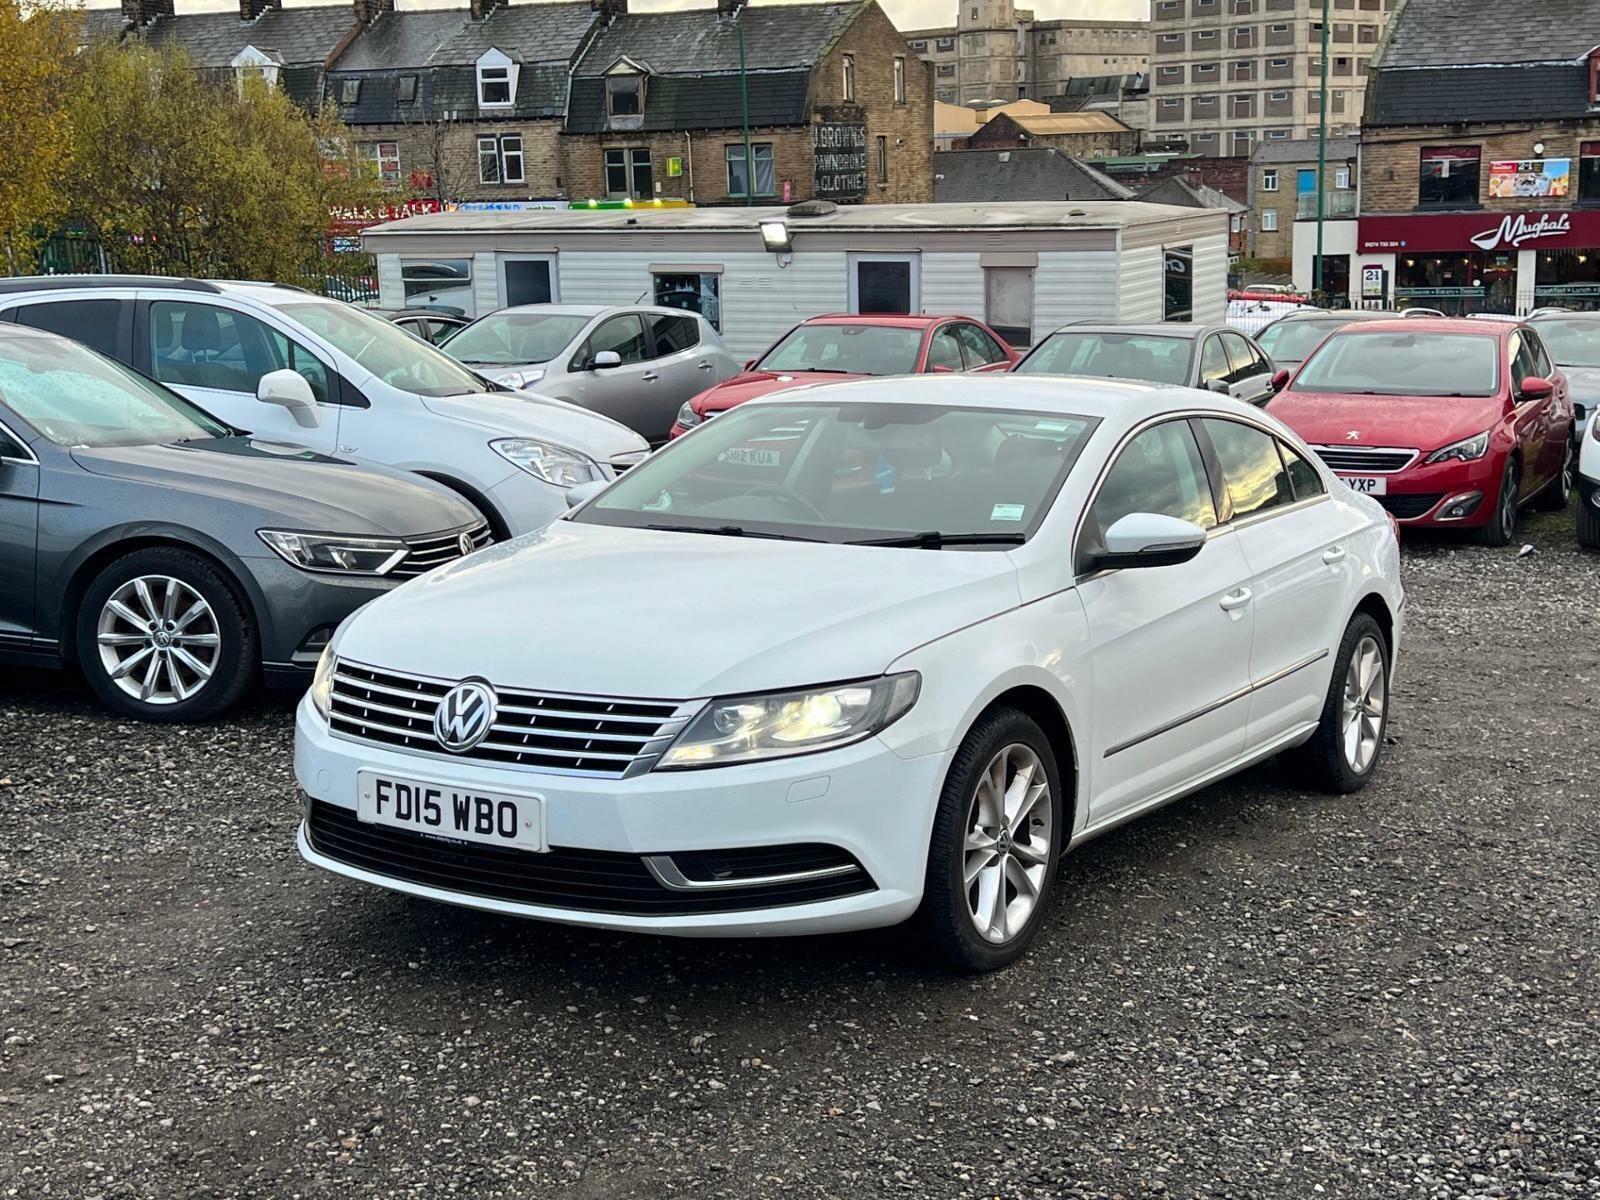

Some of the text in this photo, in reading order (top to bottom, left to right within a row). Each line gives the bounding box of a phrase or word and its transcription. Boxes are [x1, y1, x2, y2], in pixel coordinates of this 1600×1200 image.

[1478, 213, 1570, 247] Mughals
[1348, 478, 1376, 492] YXP
[376, 779, 518, 839] FD15 WBO
